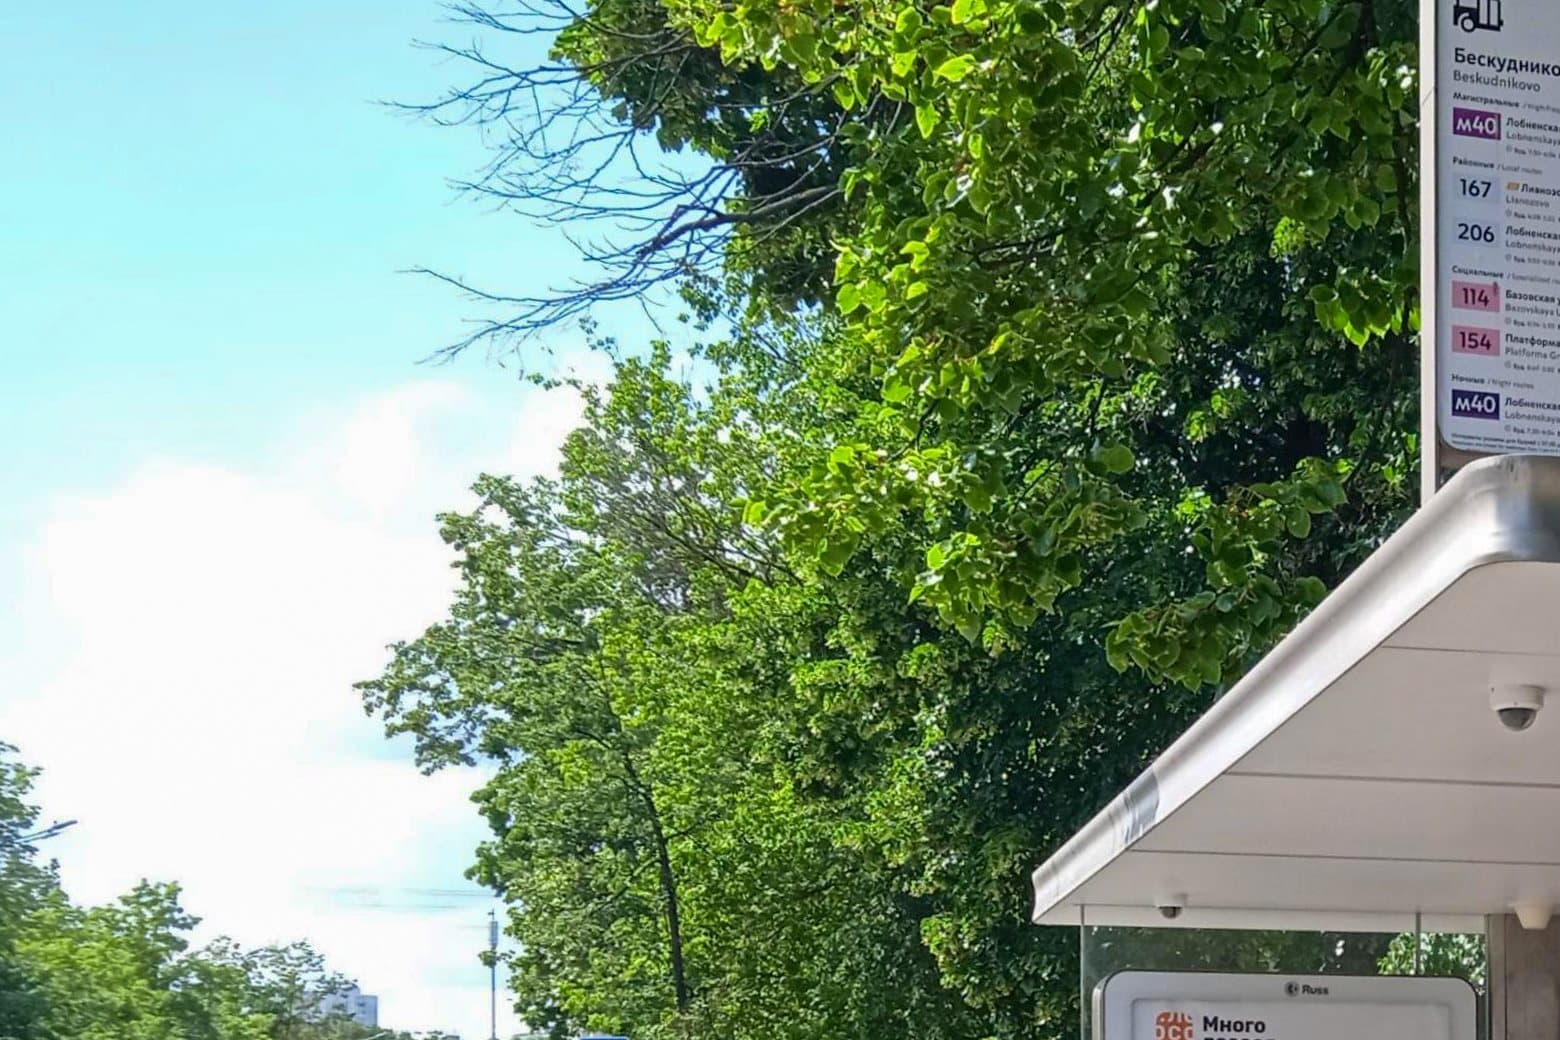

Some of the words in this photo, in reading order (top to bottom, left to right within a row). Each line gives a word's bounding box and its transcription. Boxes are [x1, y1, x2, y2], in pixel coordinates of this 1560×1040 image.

[1453, 70, 1541, 92] Beskudnikovo
[1459, 177, 1492, 199] 167
[1457, 222, 1495, 243] 206
[1462, 287, 1490, 308] 114
[1505, 289, 1555, 304] Базовская
[1458, 331, 1492, 351] 154
[1505, 334, 1560, 348] Платформа
[1302, 984, 1329, 996] Russ
[1202, 1015, 1266, 1033] Много
